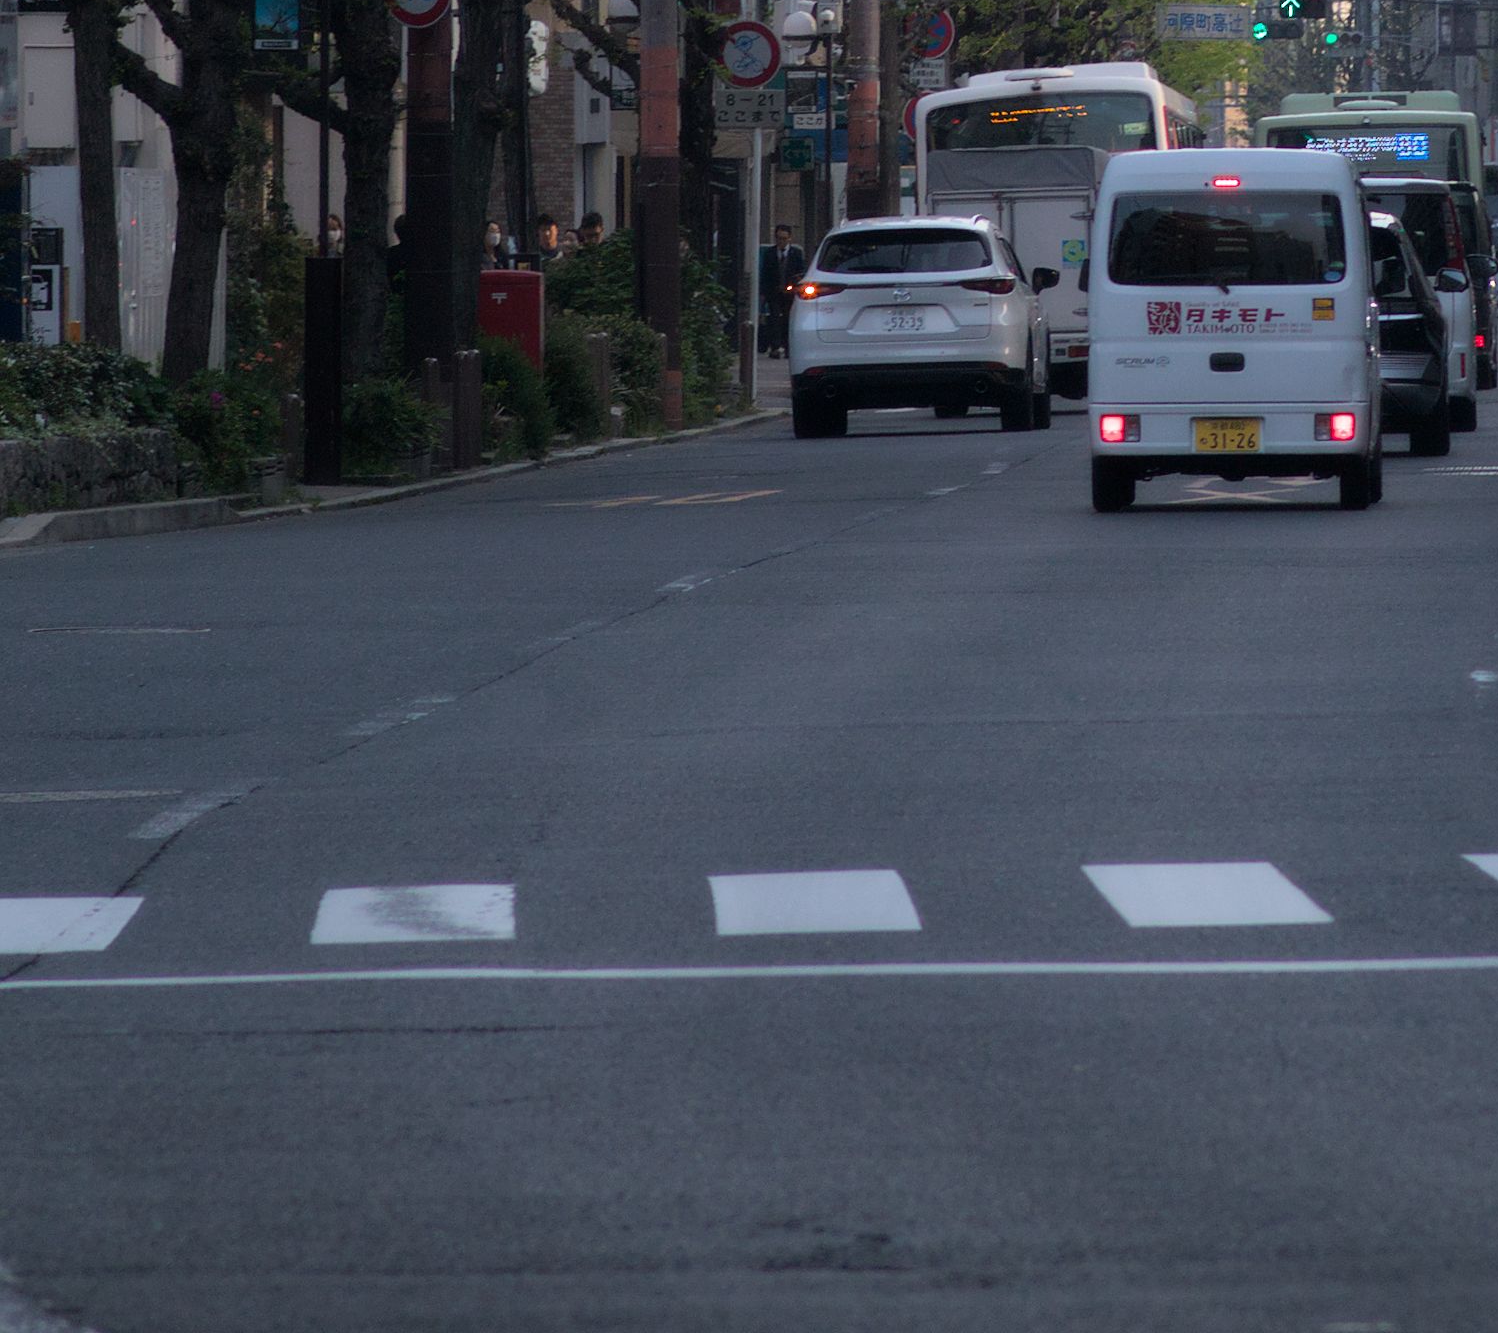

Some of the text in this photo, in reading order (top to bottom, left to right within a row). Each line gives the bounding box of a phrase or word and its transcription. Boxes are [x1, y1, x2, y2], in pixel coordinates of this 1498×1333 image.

[1164, 12, 1245, 33] 河原町高辻
[717, 109, 782, 123] ここまで
[1186, 308, 1285, 323] タキモト
[1115, 356, 1155, 365] SCRUM
[1209, 433, 1256, 449] 31-26
